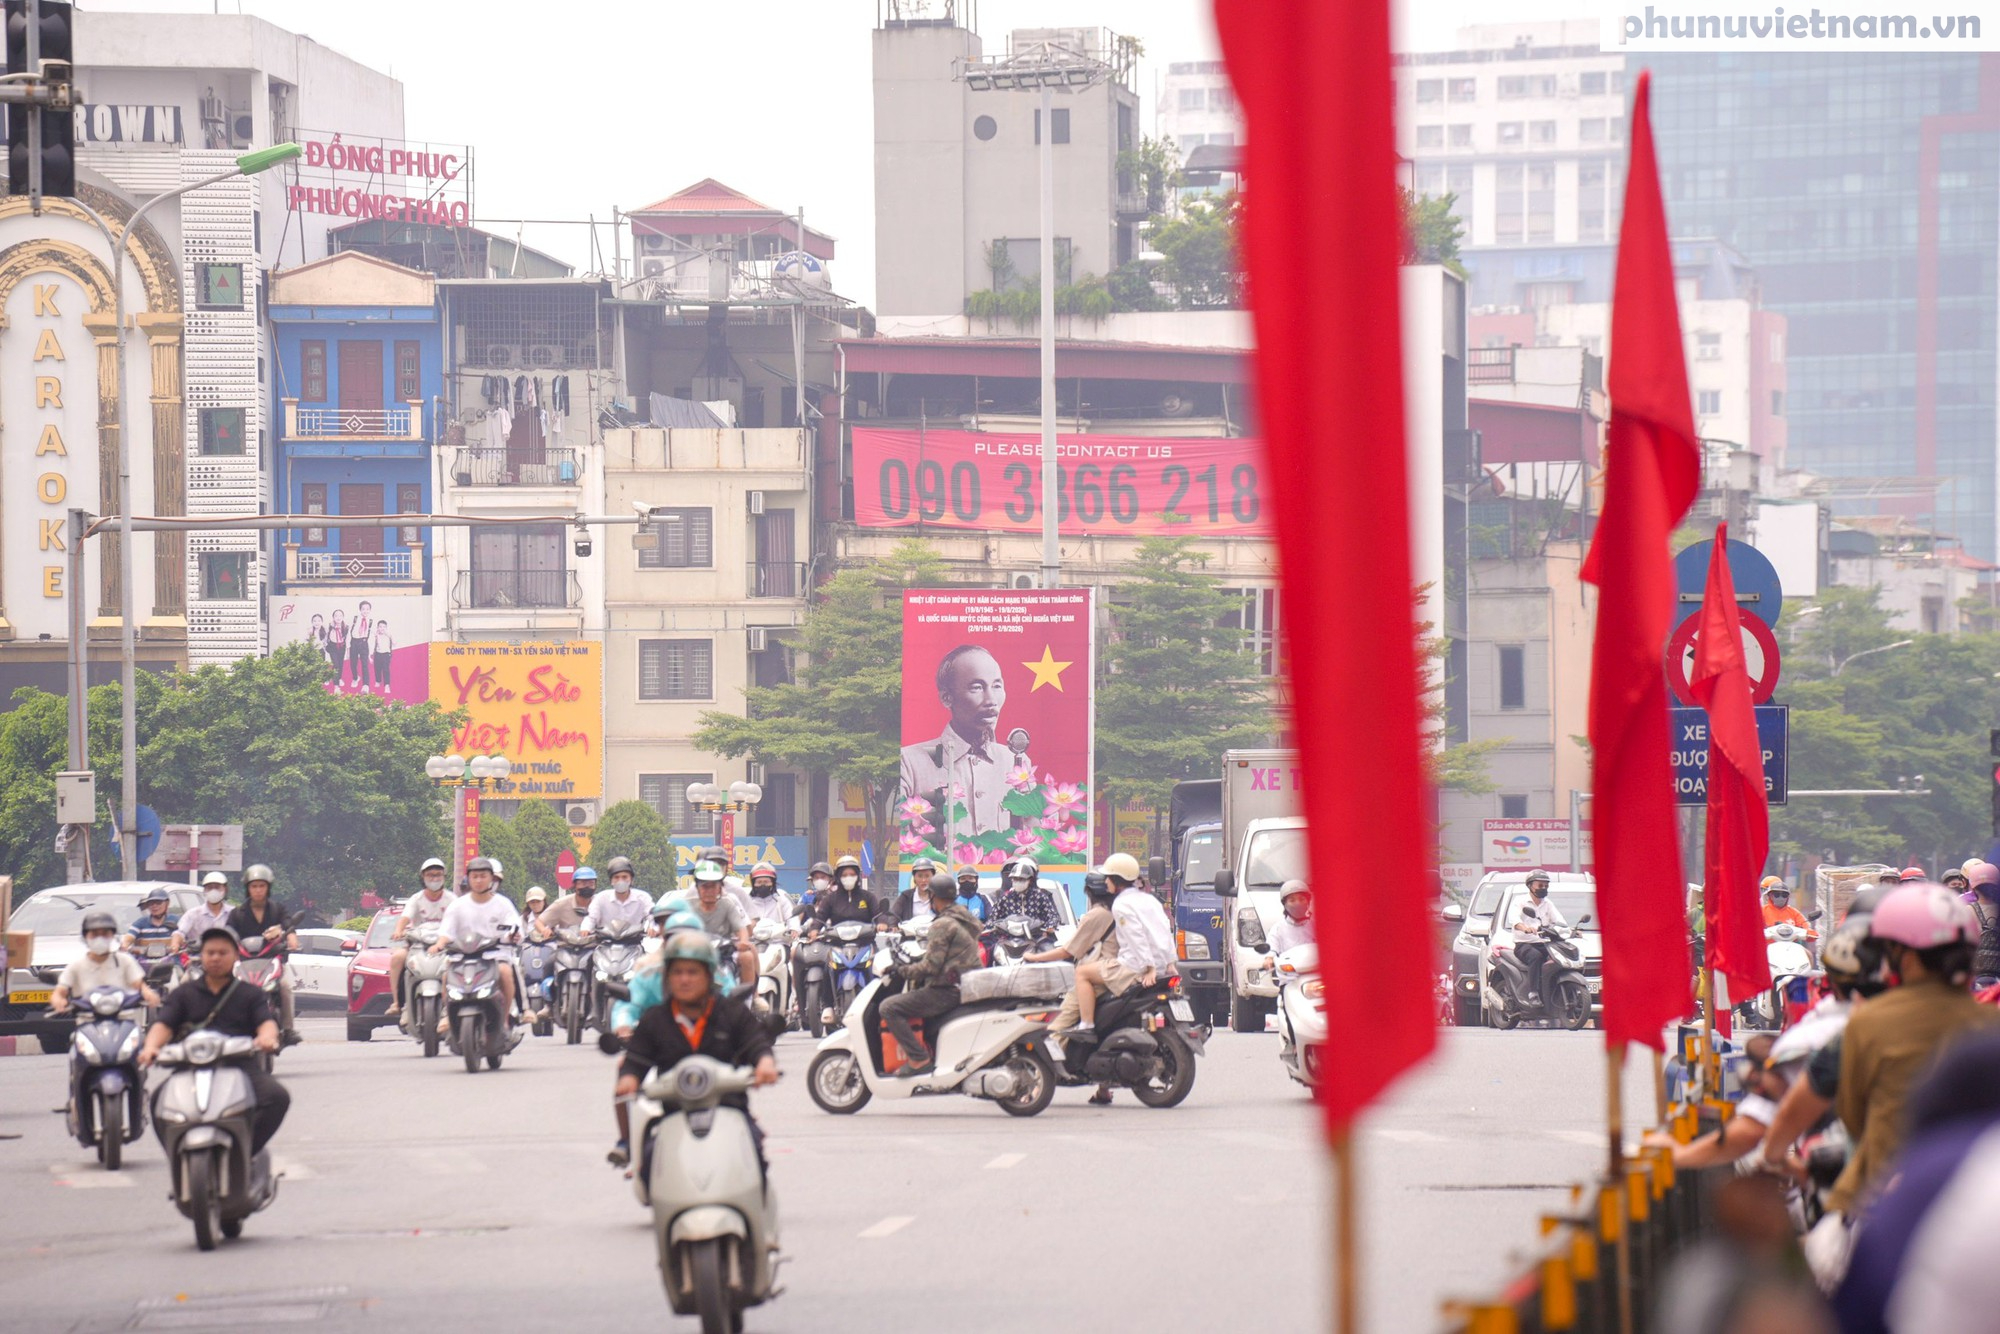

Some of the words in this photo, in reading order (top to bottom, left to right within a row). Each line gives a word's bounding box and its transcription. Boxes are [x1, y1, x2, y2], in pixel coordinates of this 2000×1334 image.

[74, 104, 175, 142] ROWN
[390, 149, 458, 186] PHỤC
[33, 284, 68, 598] KARAOKE
[975, 443, 1043, 456] PLEASE
[1056, 444, 1140, 458] CONTACT
[1148, 446, 1172, 458] US
[878, 458, 982, 521] 090
[1160, 463, 1259, 524] 218
[977, 596, 989, 604] NĂM
[990, 595, 1004, 604] CÁCH
[1005, 596, 1020, 605] MẠNG
[1021, 595, 1038, 604] THÁNG
[1039, 595, 1050, 603] TÁM
[1051, 595, 1068, 603] THÀNH
[926, 614, 940, 623] QUỐC
[977, 615, 991, 624] CỘNG
[1011, 614, 1021, 624] HỘI
[1022, 614, 1032, 622] CHỦ
[1050, 614, 1061, 624] VIỆT
[446, 645, 464, 655] CÔNG
[524, 645, 537, 655] YẾN
[540, 645, 553, 655] SÀO
[555, 645, 570, 657] VIỆT
[449, 665, 516, 705] Yến
[523, 664, 581, 704] Sào
[451, 718, 511, 755] Việt
[518, 710, 590, 756] Nam
[1684, 725, 1706, 740] XE
[510, 763, 527, 774] HAI
[530, 759, 562, 774] THÁC
[1670, 750, 1708, 770] ĐƯỢ
[520, 778, 542, 793] SẢN
[544, 778, 575, 793] XUẤT
[1251, 768, 1281, 791] XE
[1486, 821, 1503, 829] Dầu
